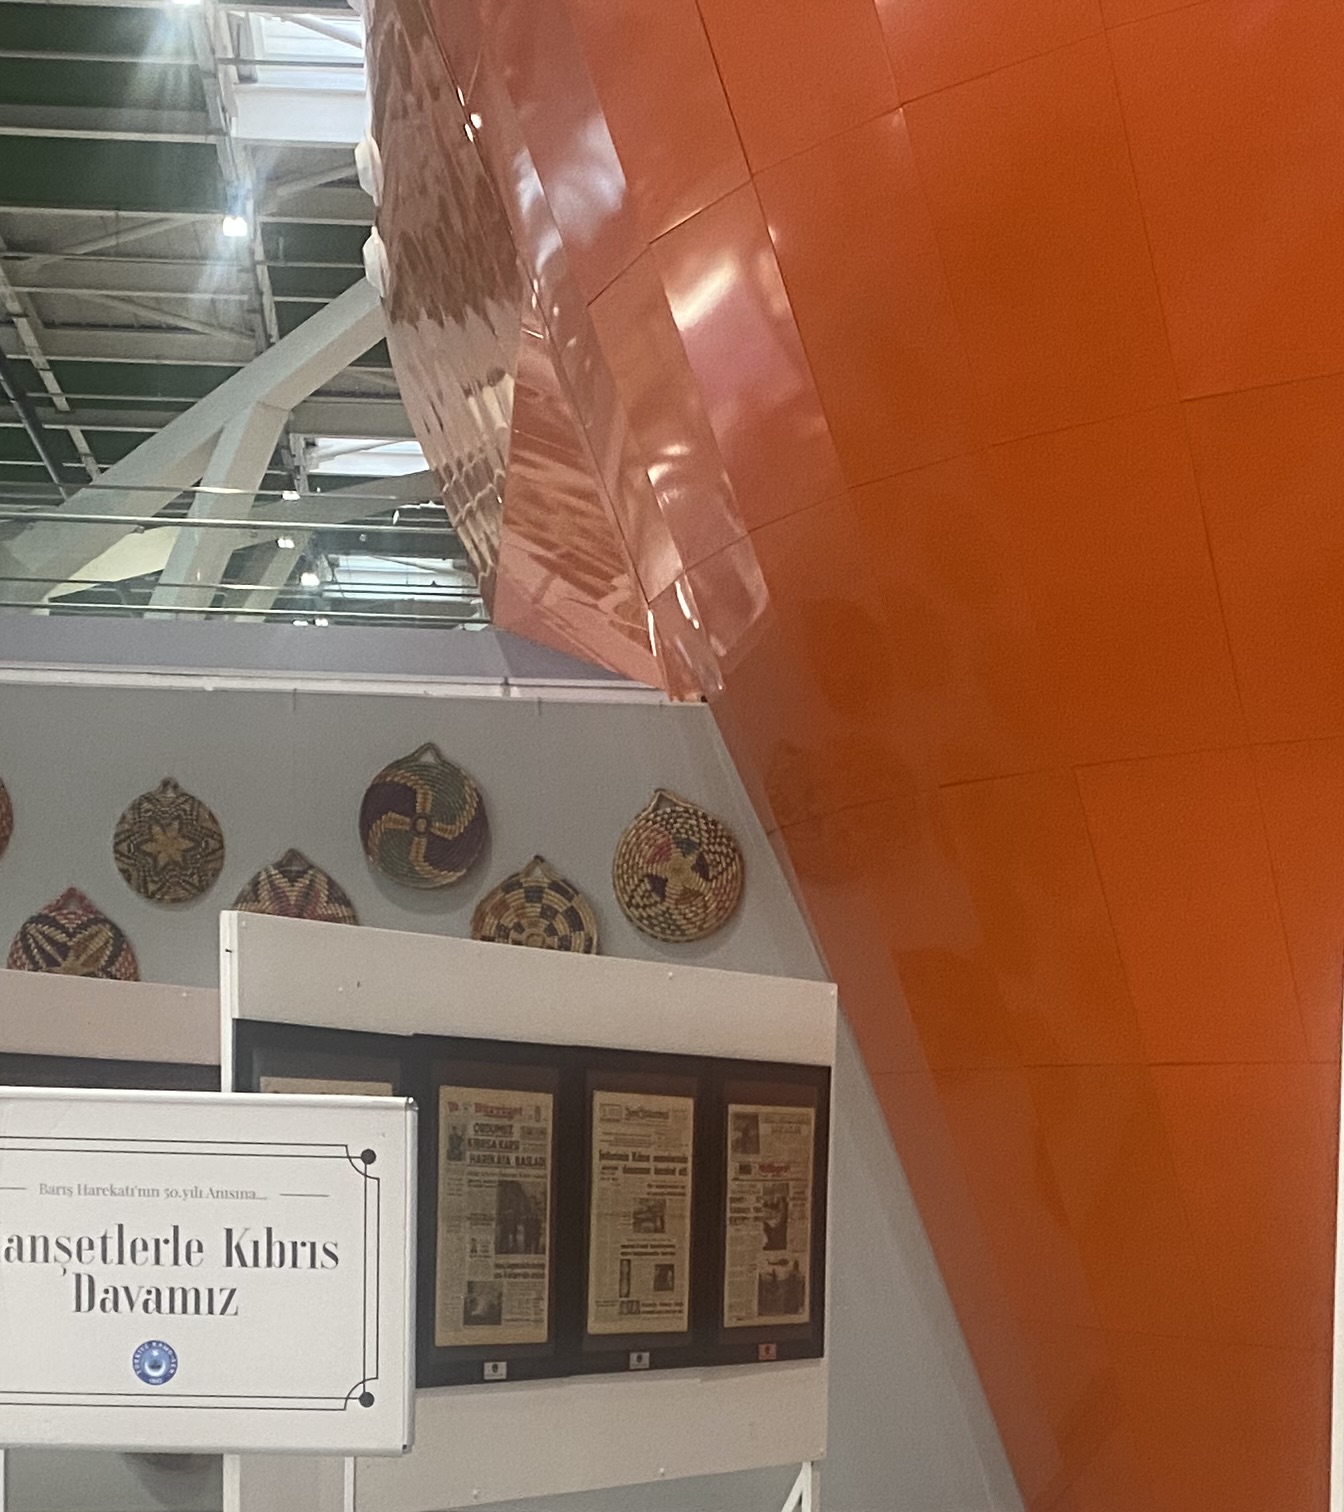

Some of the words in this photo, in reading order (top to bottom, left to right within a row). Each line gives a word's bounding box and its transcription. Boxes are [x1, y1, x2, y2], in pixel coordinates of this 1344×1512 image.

[39, 1183, 74, 1198] Barış
[77, 1183, 160, 1198] Harekatı'nın
[223, 1226, 340, 1270] Kıbrıs
[72, 1272, 240, 1317] Davamız
